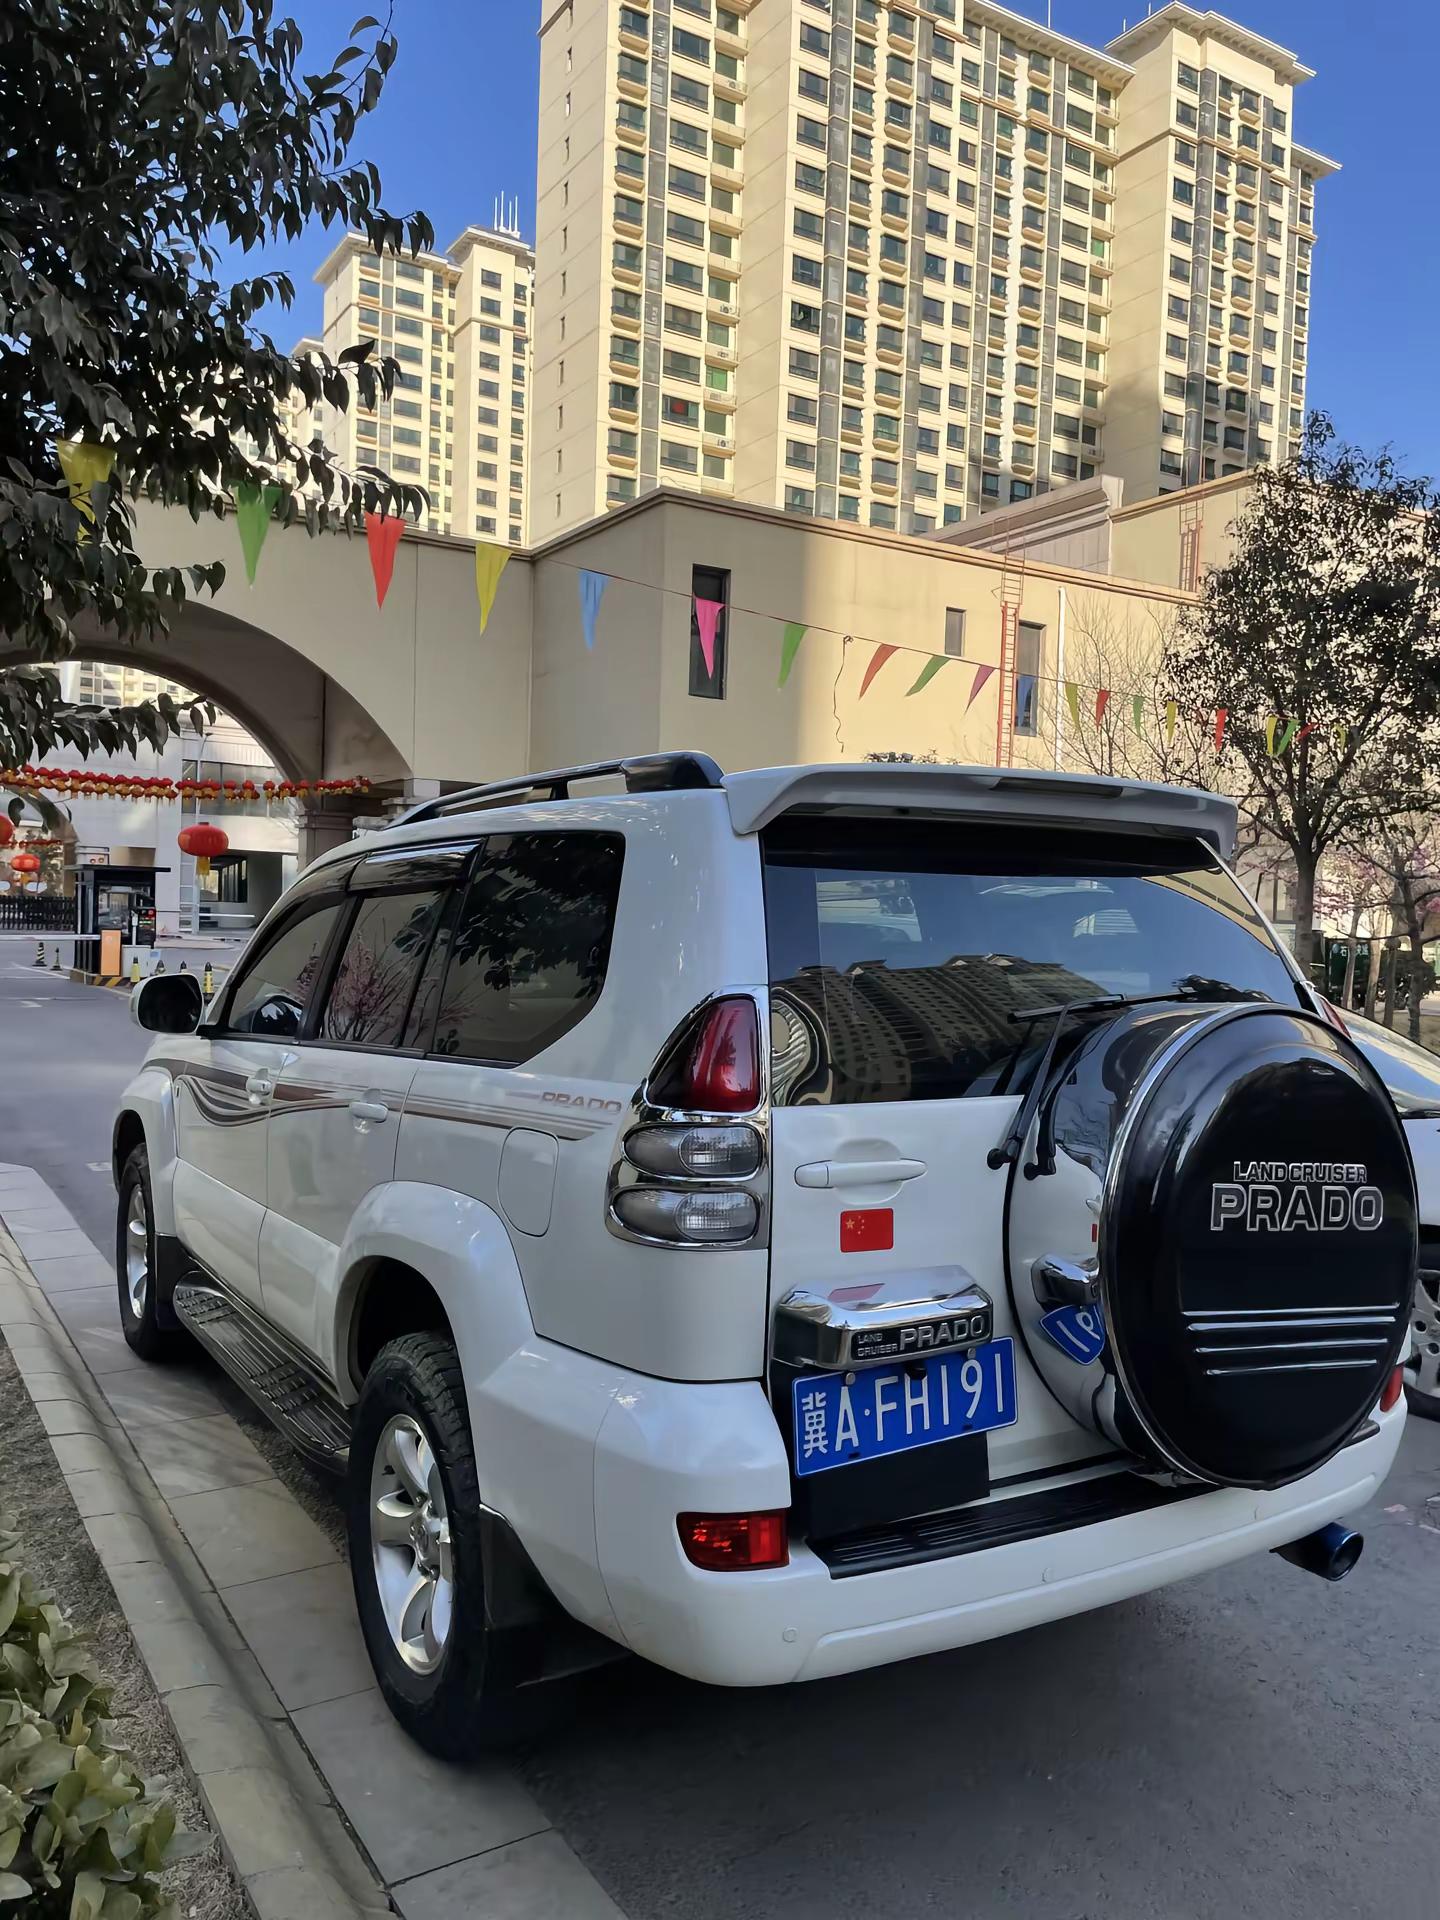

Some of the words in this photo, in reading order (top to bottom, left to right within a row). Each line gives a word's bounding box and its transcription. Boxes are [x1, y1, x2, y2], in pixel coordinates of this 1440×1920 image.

[541, 1091, 622, 1114] PRADO
[1233, 1161, 1287, 1182] LAND
[1288, 1163, 1367, 1183] CRUISER
[1210, 1183, 1384, 1231] PRADO
[857, 1333, 883, 1344] LAND
[900, 1315, 984, 1351] PRADO
[857, 1343, 898, 1357] CRUISER
